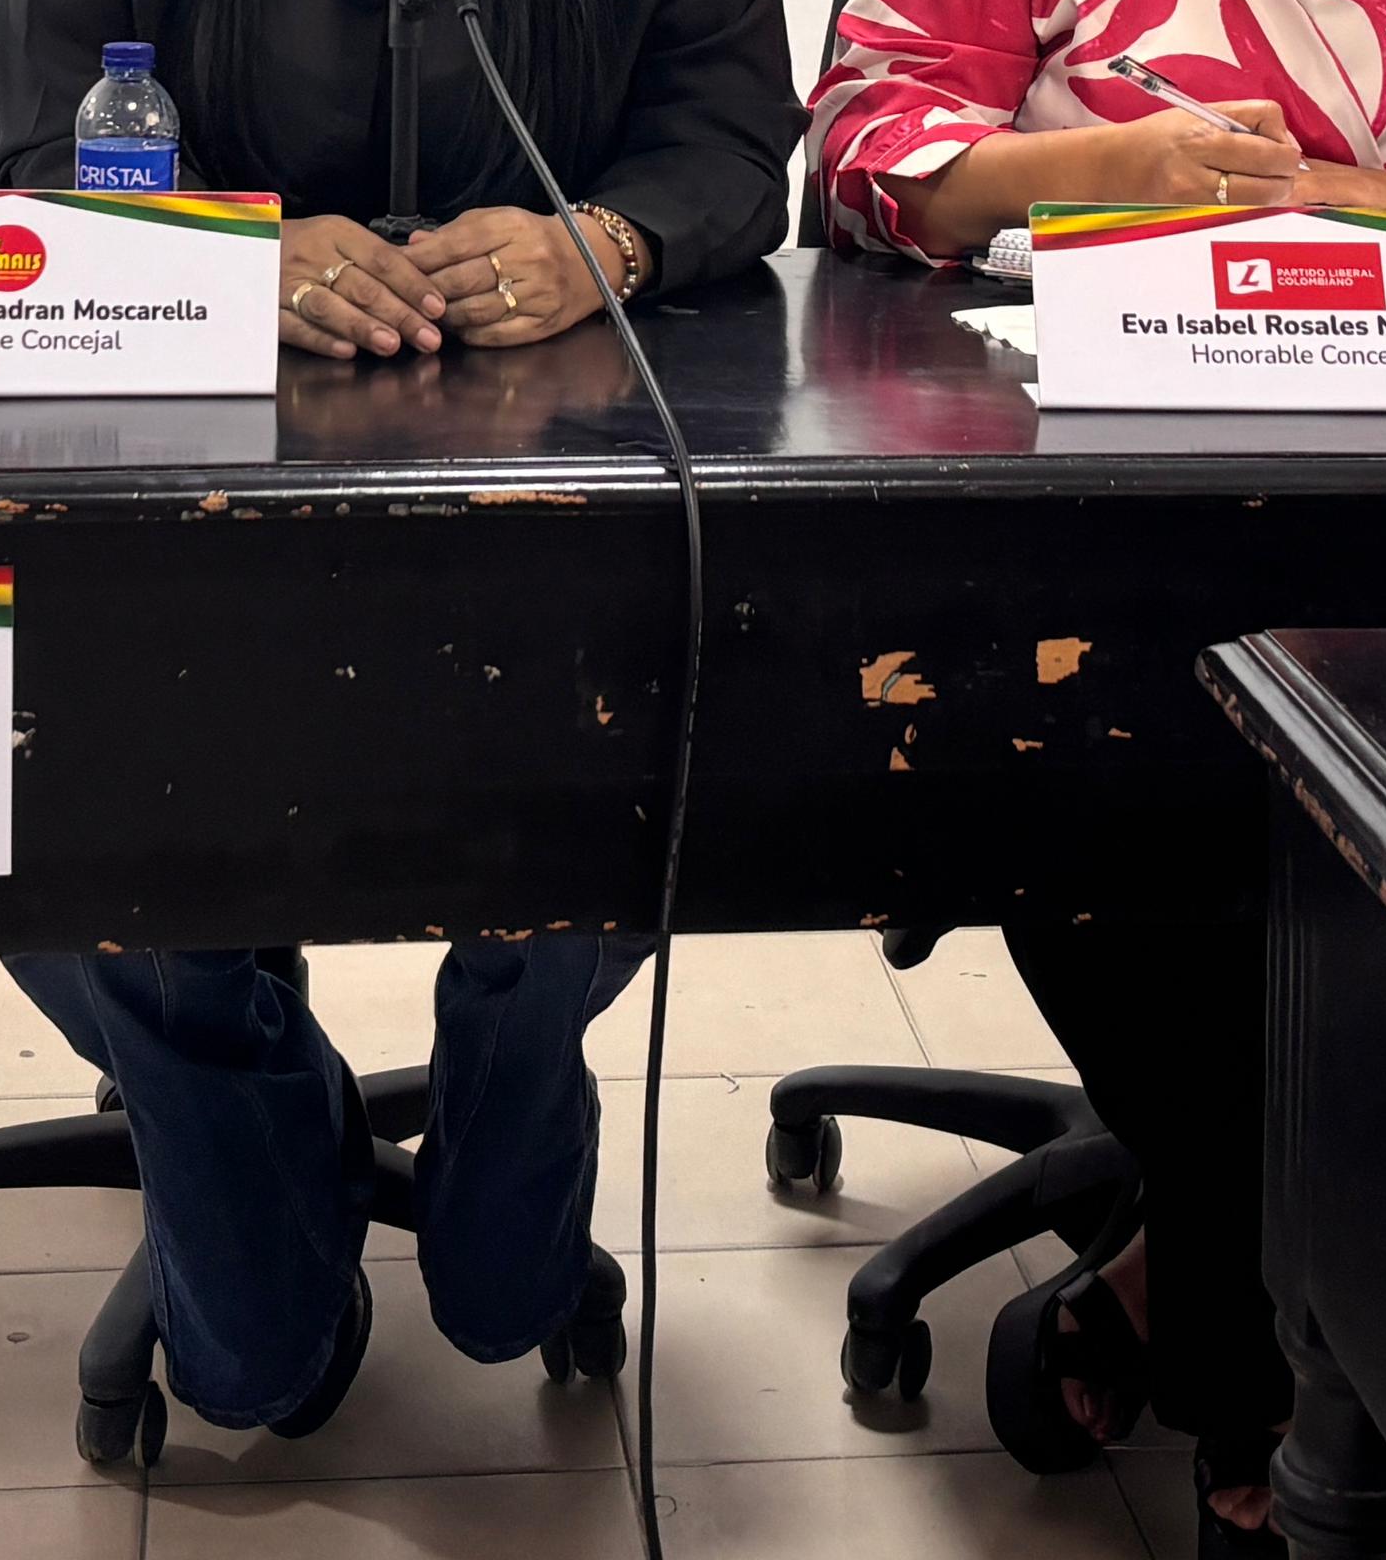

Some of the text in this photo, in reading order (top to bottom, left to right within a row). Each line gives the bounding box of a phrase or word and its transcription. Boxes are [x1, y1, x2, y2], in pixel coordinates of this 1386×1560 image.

[79, 164, 159, 187] CRISTAL
[1276, 267, 1376, 279] PARTIDO LIBERAL
[1276, 276, 1354, 288] COLOMBIANO
[73, 298, 208, 321] Moscarella
[1122, 313, 1168, 335] Eva
[1176, 313, 1258, 335] Isabel
[1265, 314, 1369, 336] Rosales
[21, 329, 122, 355] Concejal
[1191, 343, 1314, 365] Honorable
